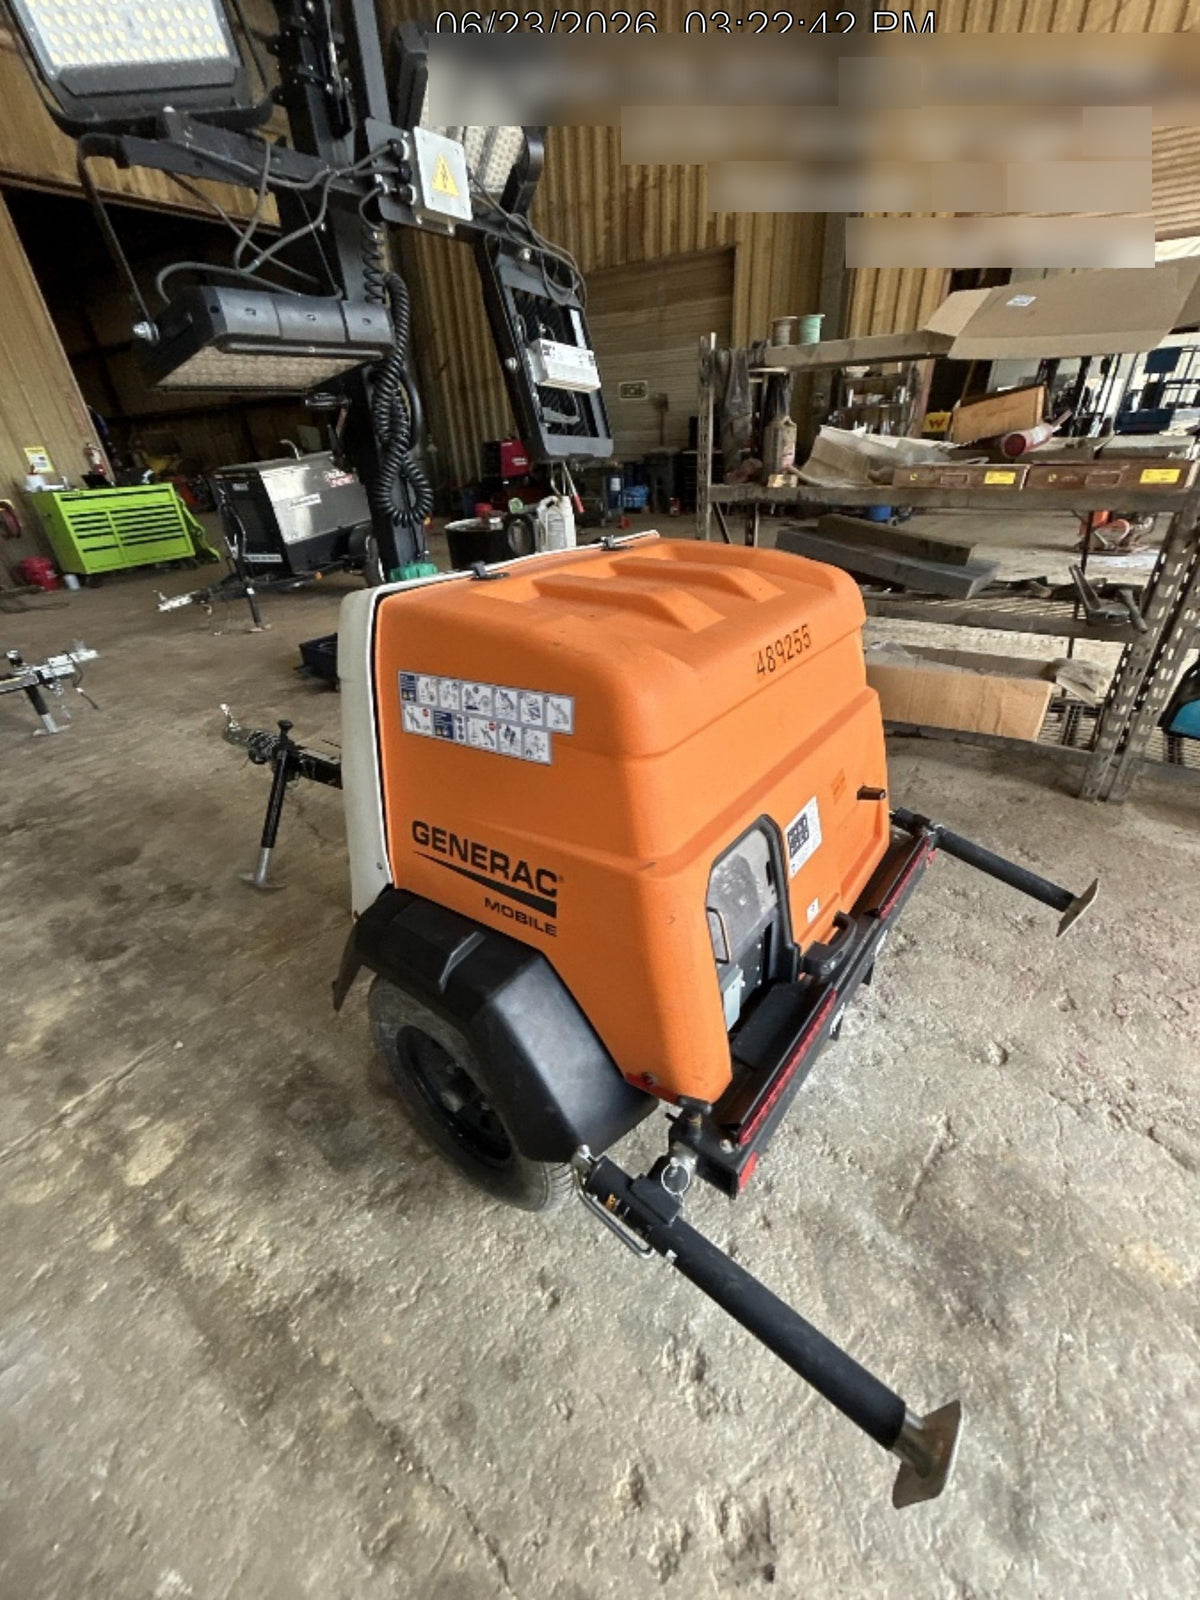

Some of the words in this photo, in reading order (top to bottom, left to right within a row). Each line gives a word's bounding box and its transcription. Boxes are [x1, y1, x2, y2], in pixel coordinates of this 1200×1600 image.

[757, 623, 812, 675] 489255
[412, 820, 558, 898] GENERAC
[484, 897, 558, 937] MOBILE
